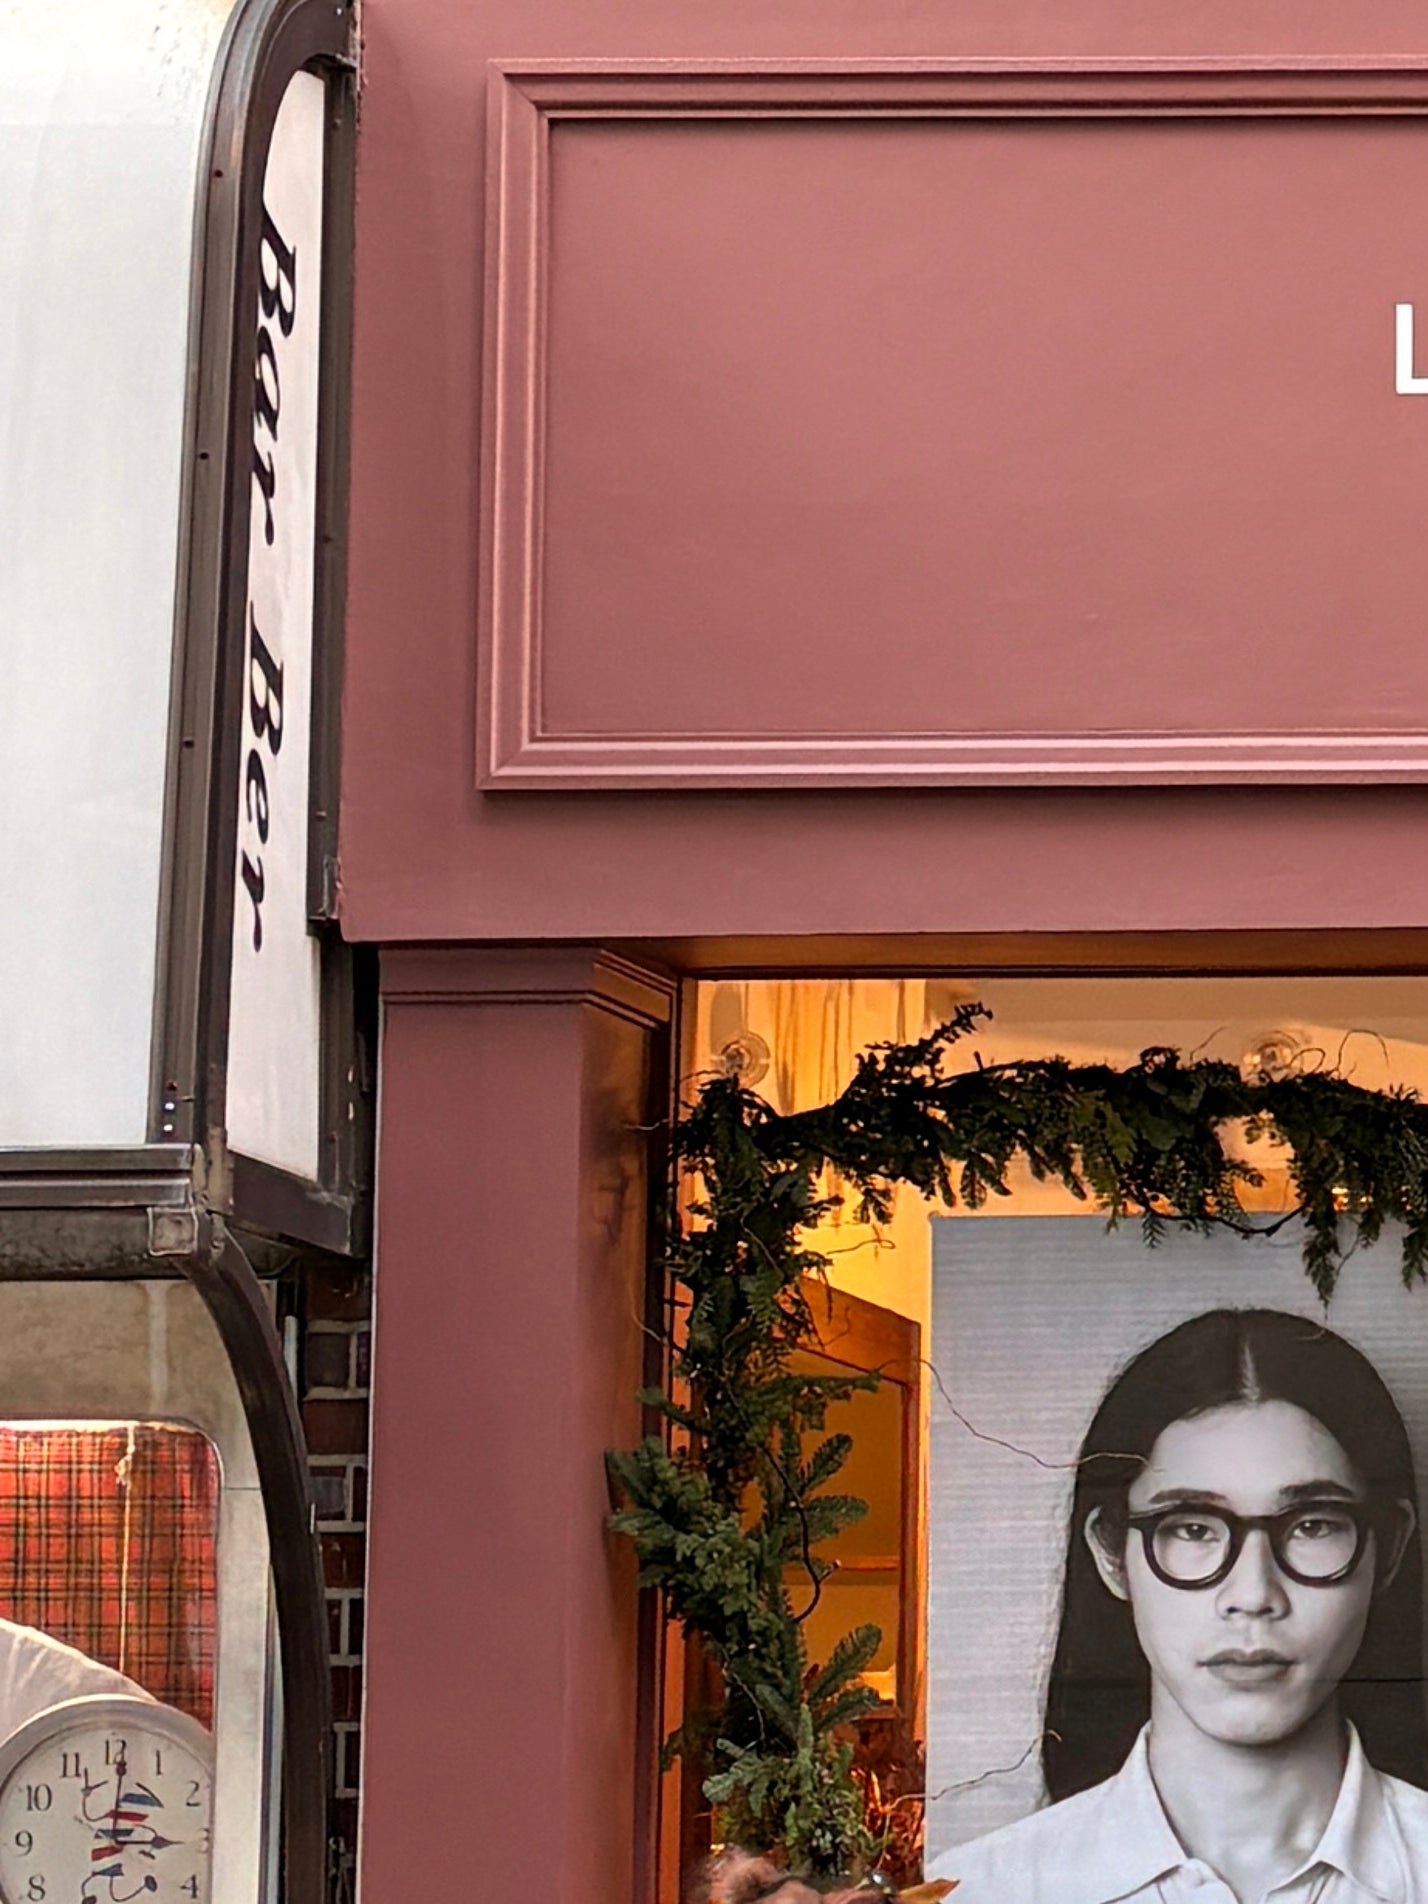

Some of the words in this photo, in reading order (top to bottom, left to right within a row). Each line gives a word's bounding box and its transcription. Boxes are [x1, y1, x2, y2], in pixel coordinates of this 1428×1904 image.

[251, 200, 297, 546] Bar
[241, 599, 284, 953] Ber
[59, 1752, 82, 1779] 11
[104, 1739, 127, 1765] 12
[154, 1750, 164, 1777] 1
[25, 1785, 52, 1812] 10
[185, 1780, 201, 1807] 2
[15, 1831, 34, 1857] 9
[26, 1875, 46, 1902] 8
[180, 1874, 199, 1899] 4
